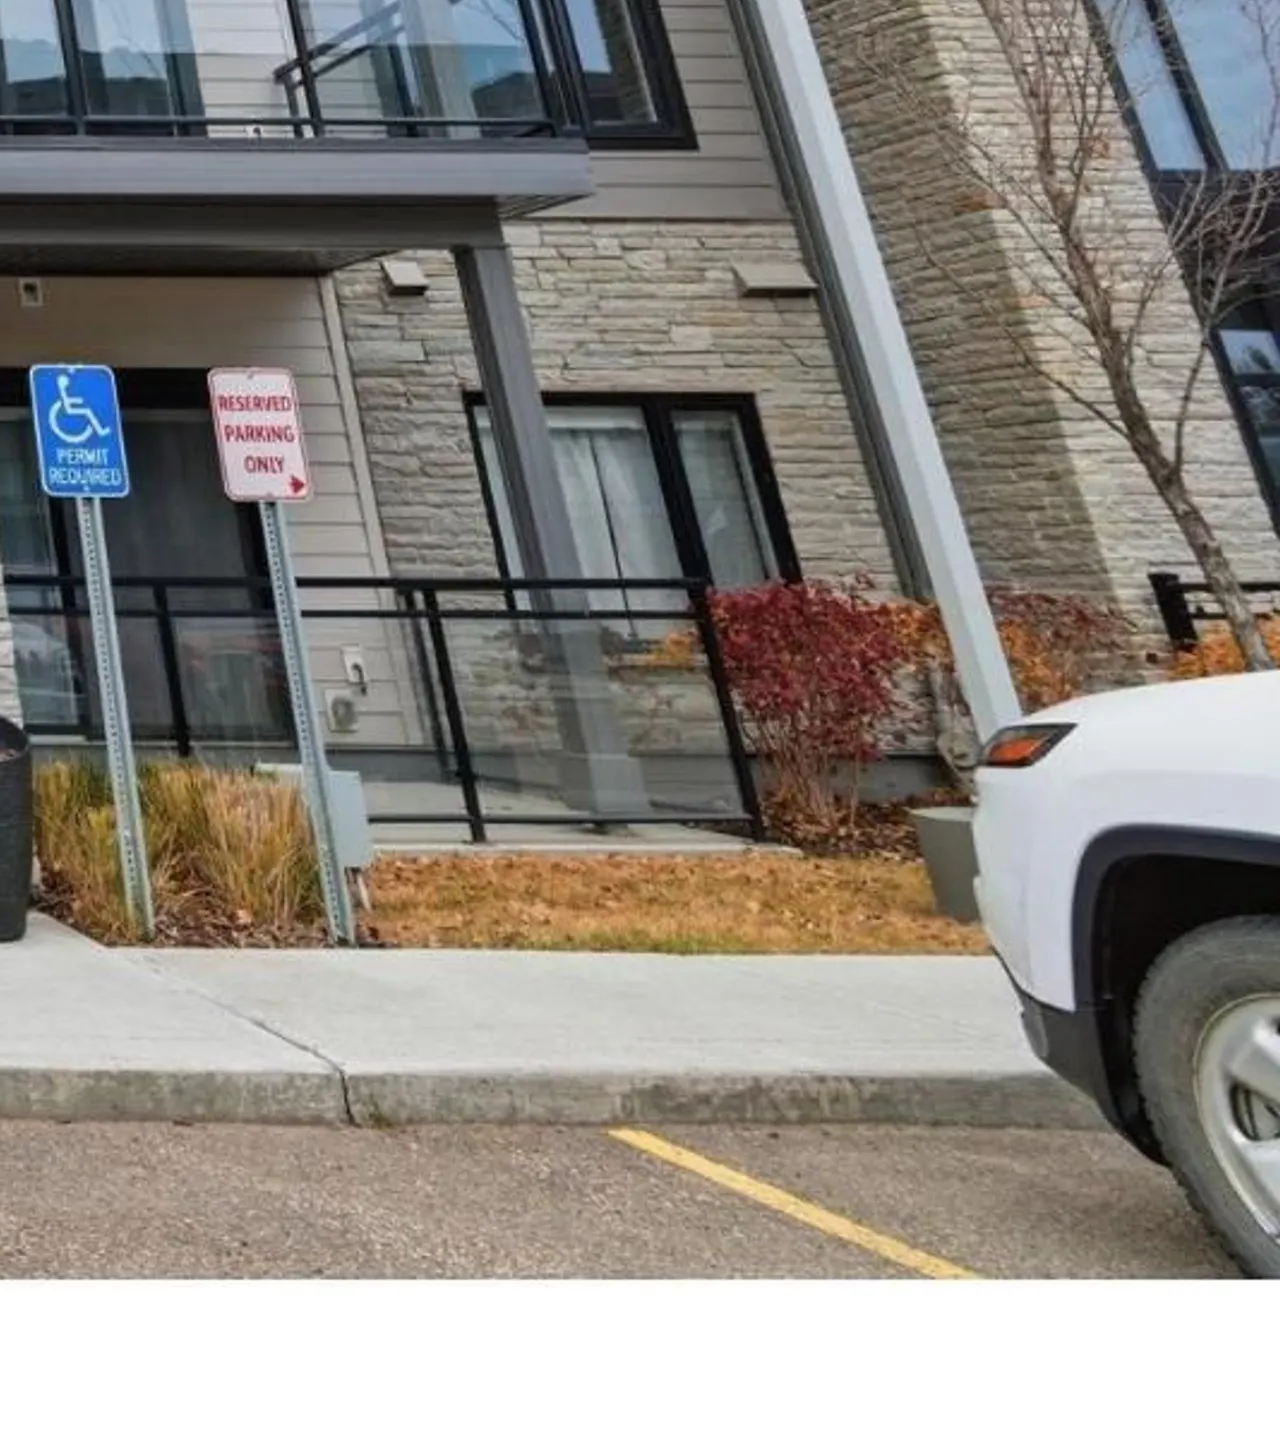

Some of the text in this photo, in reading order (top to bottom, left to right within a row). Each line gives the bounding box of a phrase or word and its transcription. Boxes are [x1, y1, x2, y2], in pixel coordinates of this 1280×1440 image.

[218, 396, 292, 411] RESERVED
[224, 425, 295, 443] PARKING
[56, 447, 109, 465] PERMIT
[244, 456, 285, 473] ONLY
[48, 467, 122, 485] REQUIRED
